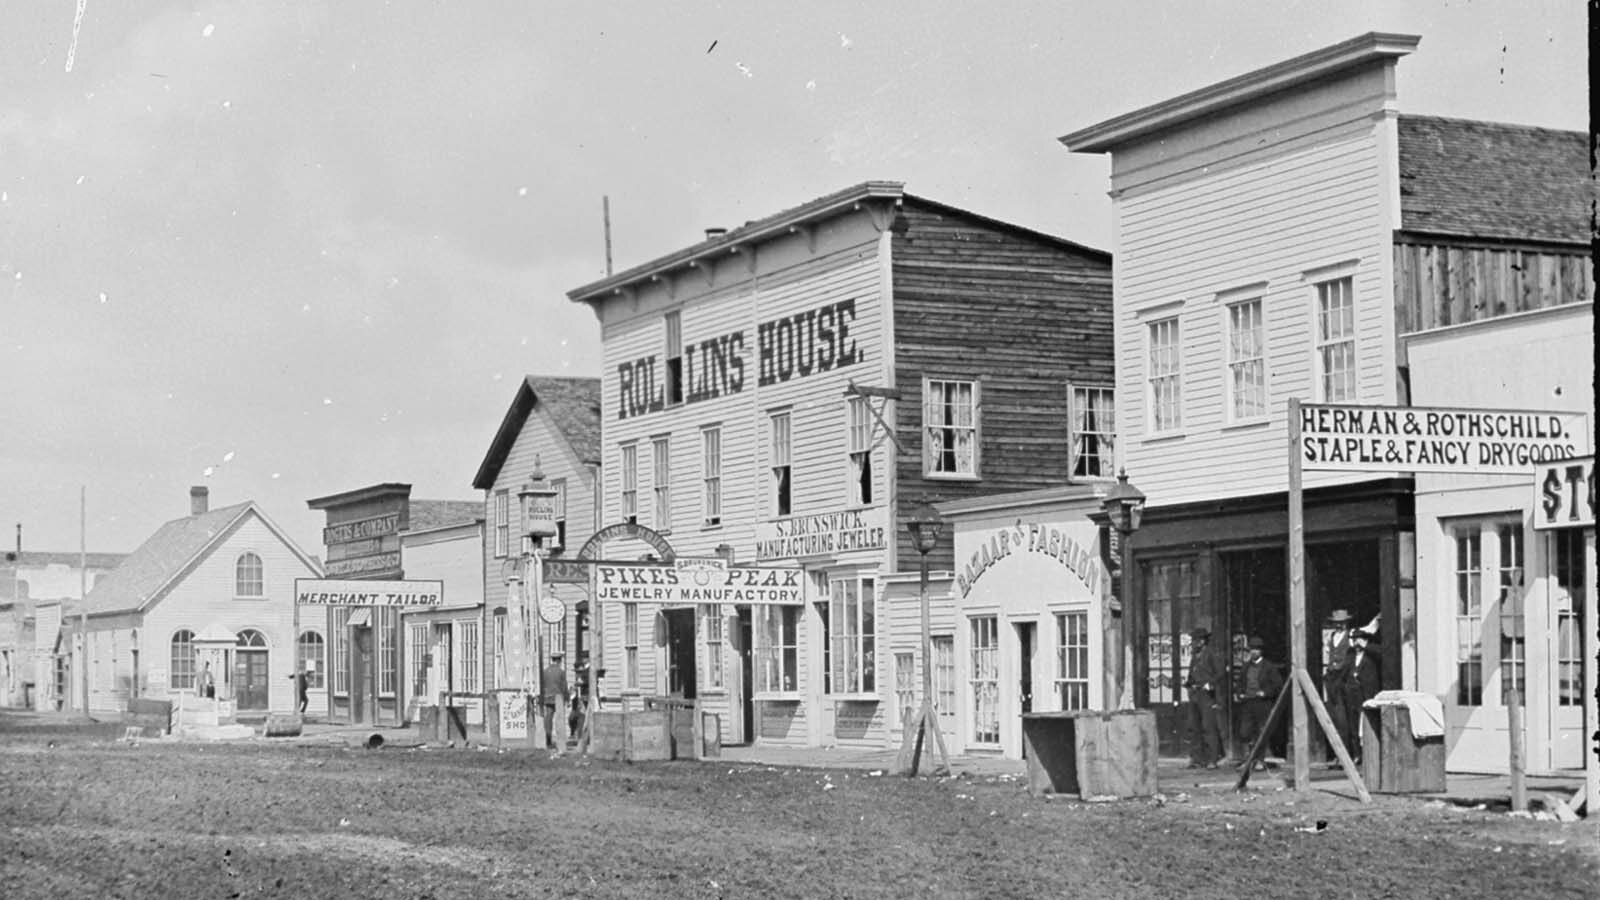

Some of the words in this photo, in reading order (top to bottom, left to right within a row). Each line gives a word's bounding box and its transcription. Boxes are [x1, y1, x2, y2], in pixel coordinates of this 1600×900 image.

[758, 299, 864, 387] HOUSE.
[1427, 412, 1570, 439] ROTHSCHILD.
[756, 533, 833, 558] MANUFACTURING
[837, 528, 888, 550] JEWELER.
[957, 529, 1012, 599] BAZAAR
[1028, 522, 1098, 596] FASHION
[599, 567, 679, 585] PIKES
[724, 570, 801, 587] PEAK
[298, 592, 379, 605] MERCHANT
[386, 594, 440, 605] TAILOR.
[599, 587, 672, 599] JEWELRY
[680, 588, 802, 601] MANUFACTORY.
